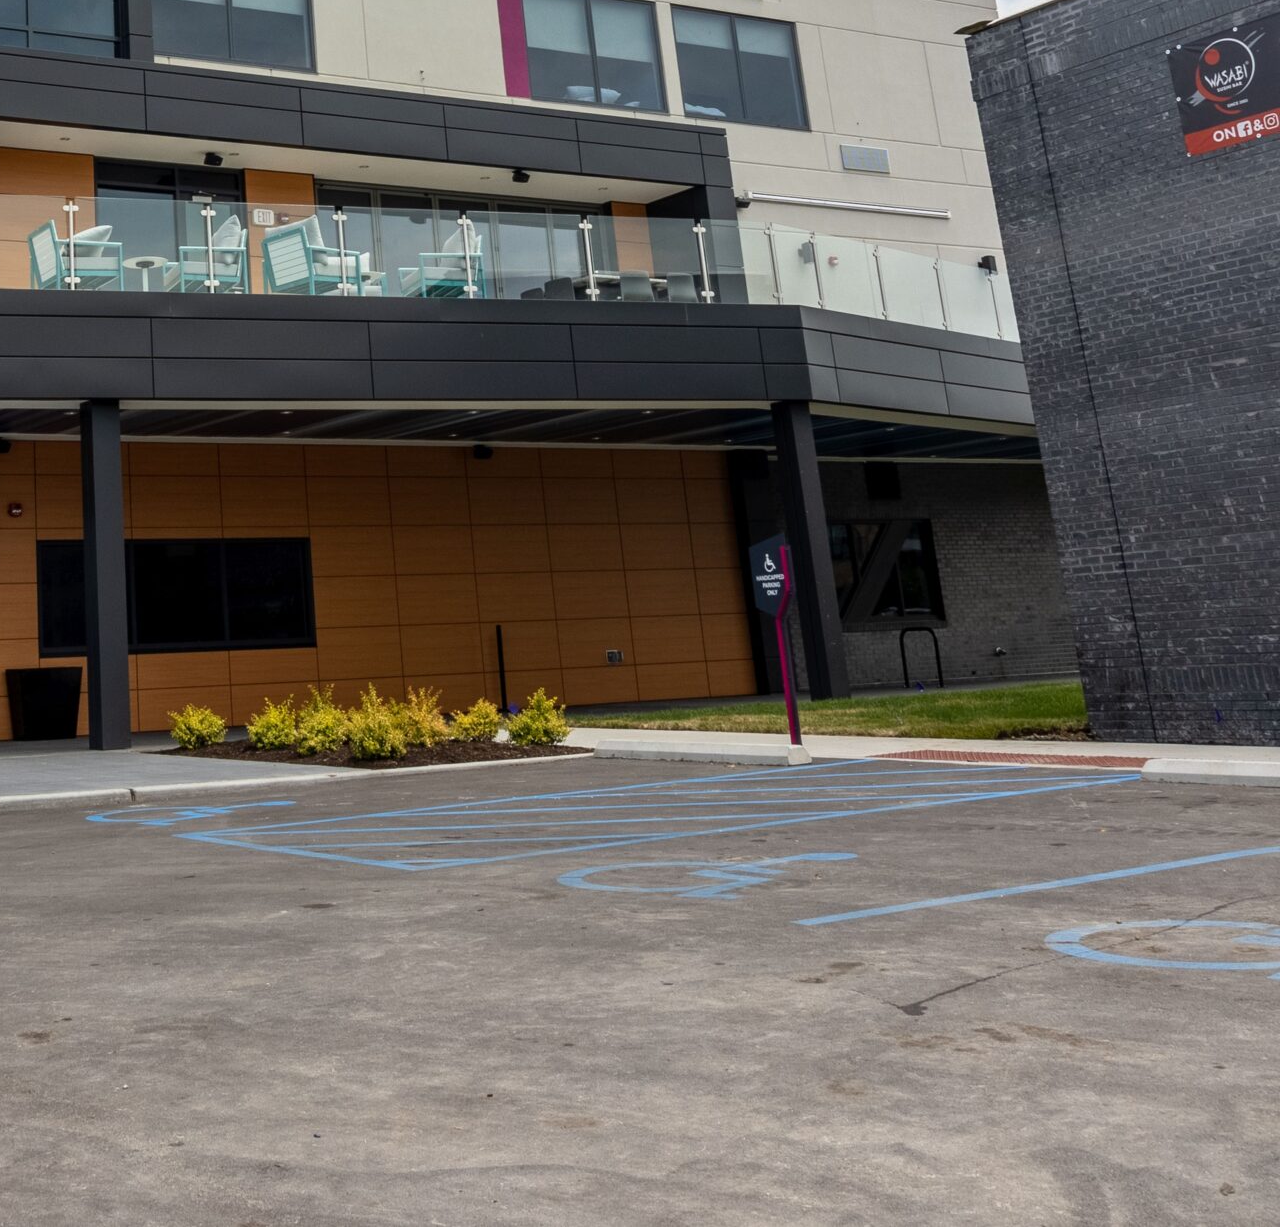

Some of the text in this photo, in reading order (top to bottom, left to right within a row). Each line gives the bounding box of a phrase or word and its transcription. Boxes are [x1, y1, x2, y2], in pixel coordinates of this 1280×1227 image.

[1204, 64, 1248, 88] WASABI
[1213, 126, 1237, 142] ON
[257, 210, 272, 223] EXIT
